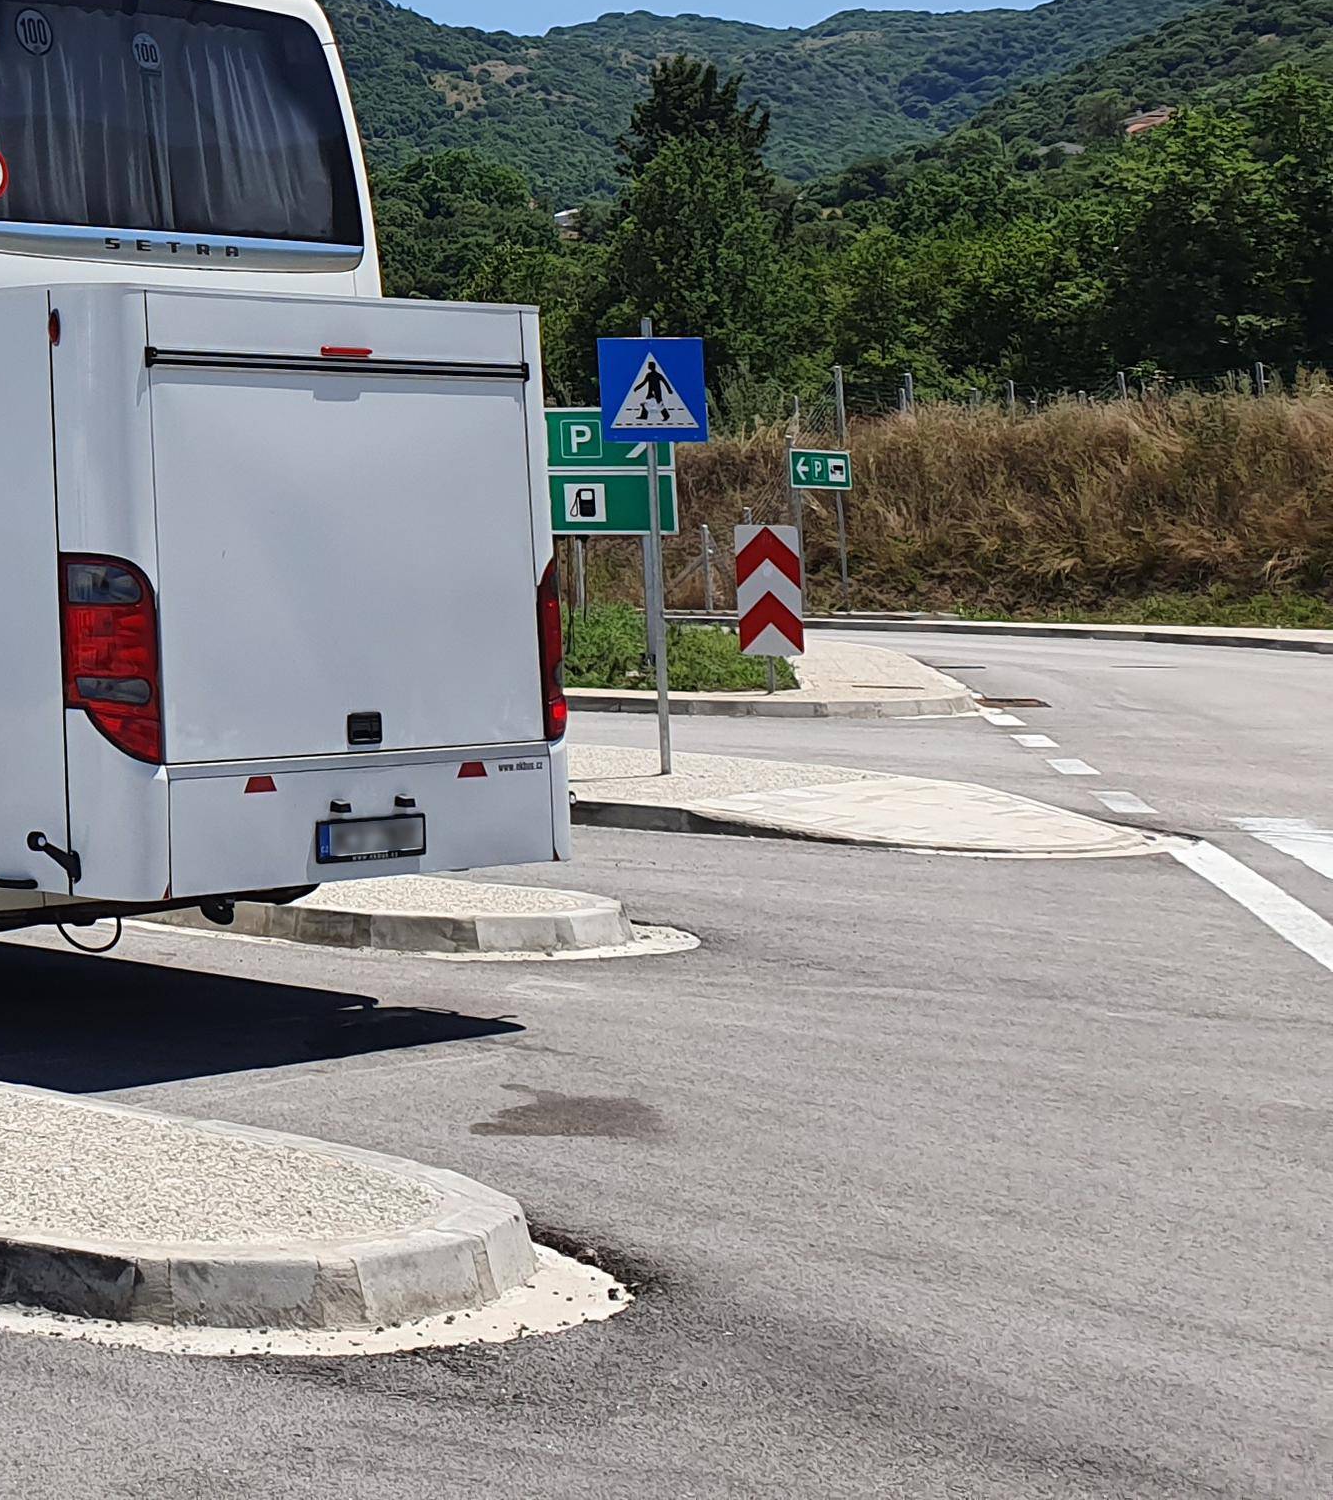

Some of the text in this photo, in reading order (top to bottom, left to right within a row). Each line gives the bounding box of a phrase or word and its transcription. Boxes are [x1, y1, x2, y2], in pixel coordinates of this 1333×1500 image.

[20, 18, 48, 46] 100
[135, 43, 159, 63] 100
[105, 237, 239, 257] SETRA
[570, 425, 592, 453] P
[814, 460, 822, 478] P
